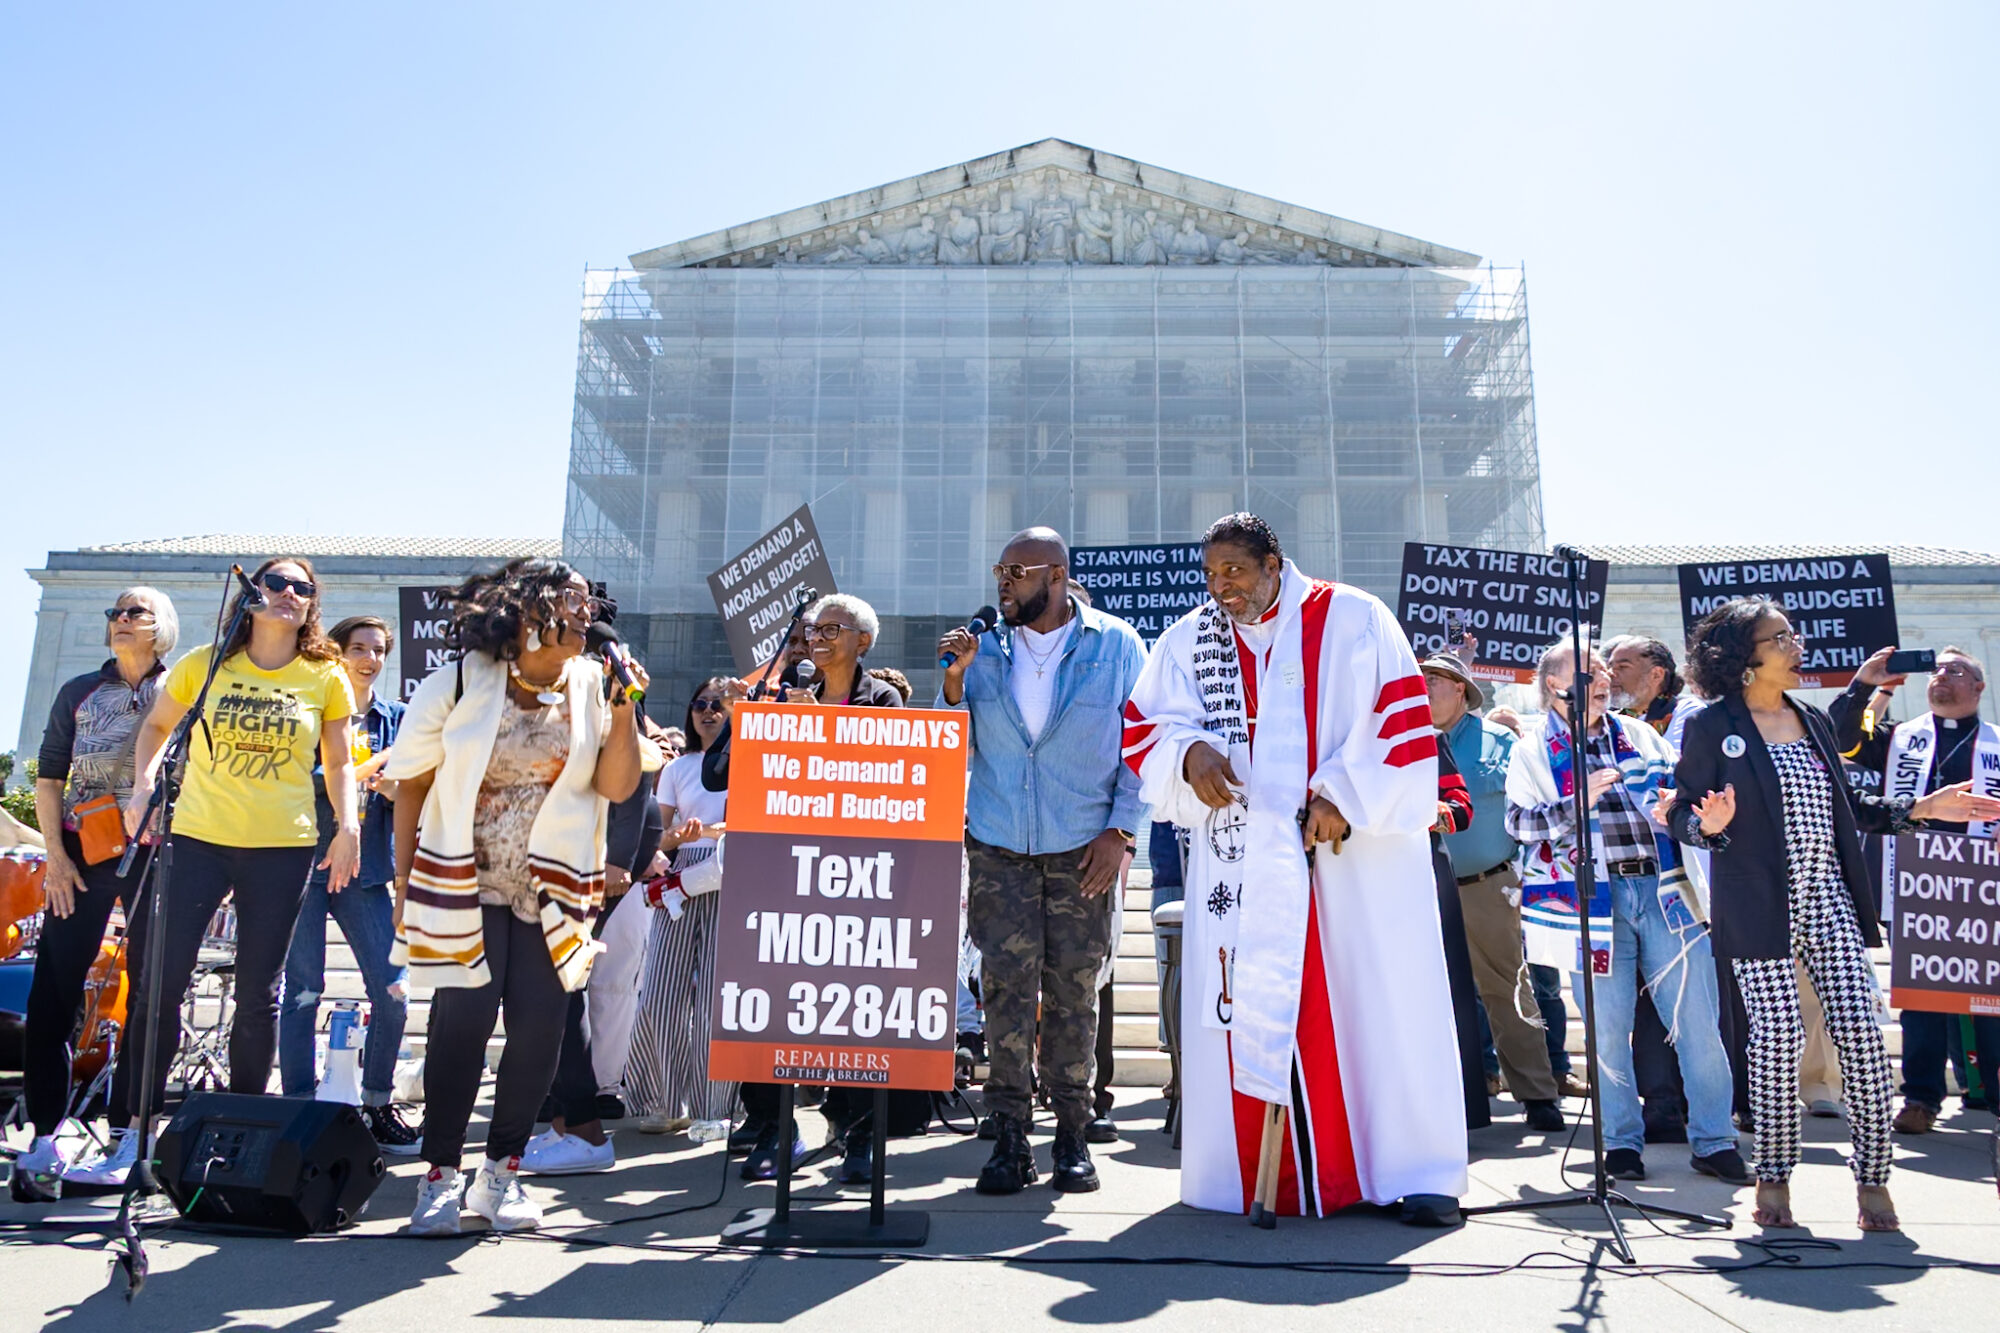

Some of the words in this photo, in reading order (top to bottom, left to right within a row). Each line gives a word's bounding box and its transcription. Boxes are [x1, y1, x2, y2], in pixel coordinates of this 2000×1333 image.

[718, 564, 742, 590] WE
[740, 528, 793, 576] DEMAND
[794, 518, 806, 539] A
[1075, 549, 1166, 566] STARVING
[1170, 548, 1185, 563] 11
[1424, 546, 1470, 569] TAX
[1476, 551, 1518, 573] THE
[723, 578, 769, 620] MORAL
[767, 539, 820, 591] BUDGET!
[1076, 572, 1142, 588] PEOPLE
[1146, 571, 1162, 586] IS
[1166, 570, 1207, 586] VIOL
[1405, 573, 1478, 598] DON’T
[1483, 582, 1530, 604] CUT
[1698, 567, 1738, 586] WE
[1742, 560, 1846, 585] DEMAND
[1852, 560, 1871, 578] A
[1104, 595, 1133, 609] WE
[1783, 587, 1885, 610] BUDGET!
[749, 599, 783, 635] FUND
[1494, 614, 1574, 637] MILLIO
[1800, 618, 1847, 639] LIFE
[751, 633, 779, 668] NOT
[1486, 640, 1541, 664] PEOP
[1800, 648, 1866, 669] EATH!
[1225, 698, 1241, 711] My
[212, 711, 301, 736] FIGHT
[212, 730, 298, 747] POVERTY
[740, 712, 827, 743] MORAL
[835, 716, 960, 749] MONDAYS
[1907, 735, 1927, 752] DO
[210, 741, 292, 780] POOR
[762, 753, 801, 780] We
[807, 755, 905, 785] Demand
[911, 764, 926, 785] a
[1894, 753, 1923, 799] JUSTIC
[766, 790, 834, 818] Moral
[841, 793, 926, 823] Budget
[1915, 832, 1965, 863] TAX
[791, 845, 895, 900] Text
[1899, 871, 1974, 903] DON’T
[746, 911, 933, 970] ‘MORAL’
[1902, 912, 1951, 942] FOR
[1955, 918, 1988, 945] 40
[1910, 953, 1980, 985] POOR
[721, 981, 771, 1033] to
[787, 981, 948, 1041] 32846
[774, 1049, 890, 1069] REPAIRERS
[774, 1067, 792, 1077] OF
[796, 1068, 823, 1079] THE
[837, 1069, 888, 1082] BREACH
